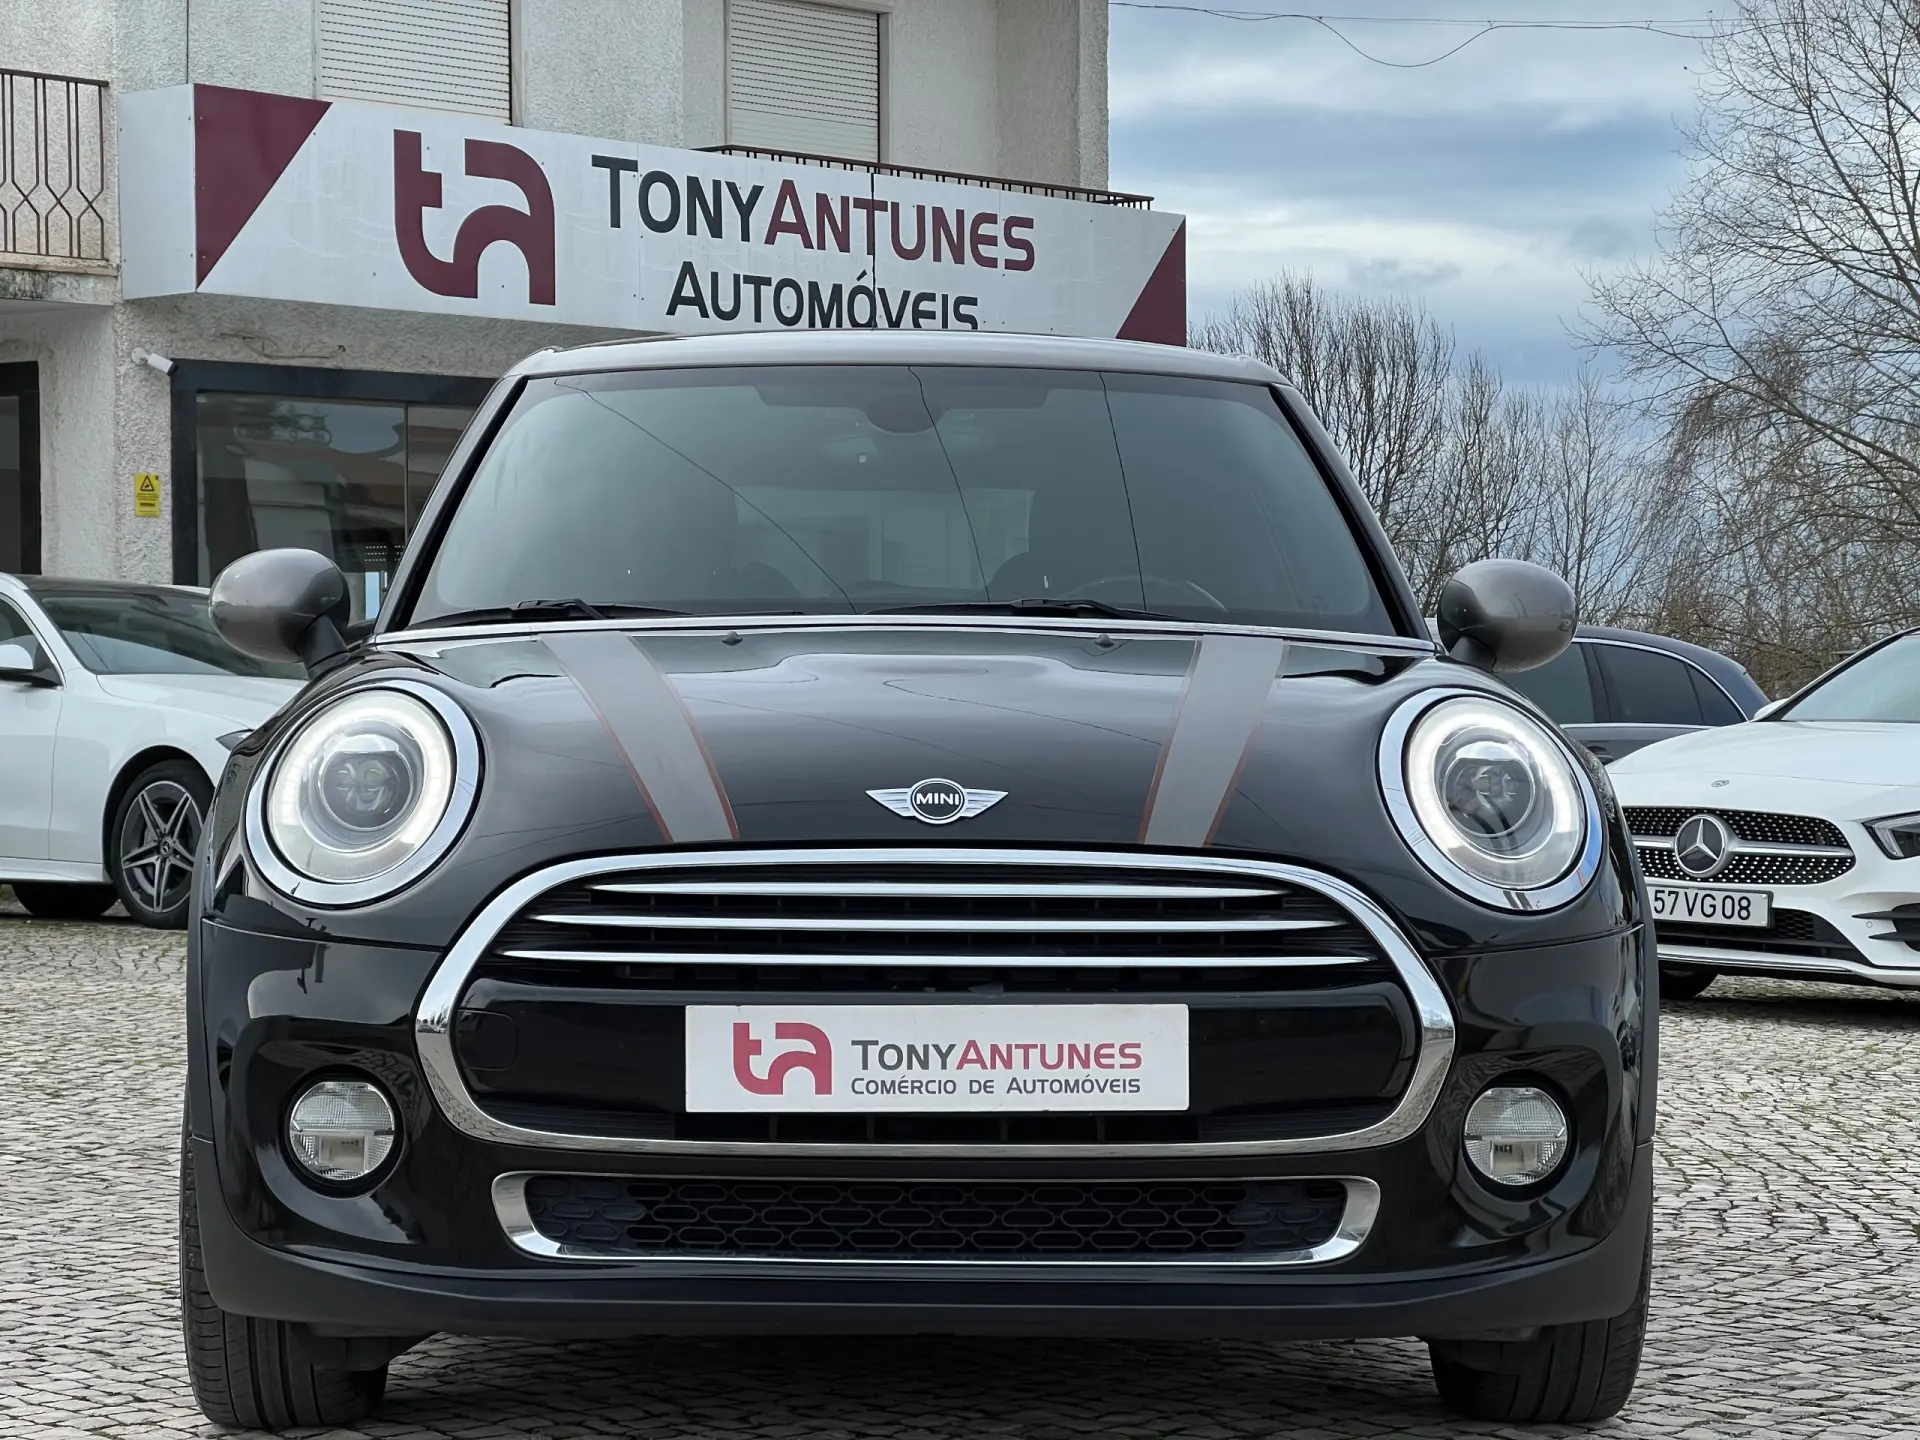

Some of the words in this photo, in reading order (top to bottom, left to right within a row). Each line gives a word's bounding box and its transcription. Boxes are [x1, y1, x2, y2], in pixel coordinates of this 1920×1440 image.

[665, 261, 979, 330] AUTOMÓVEIS
[916, 792, 960, 805] MINI
[850, 1075, 957, 1095] COMÉRCIO
[969, 1080, 995, 1095] DE
[1006, 1075, 1141, 1095] AUTOMÓVEIS
